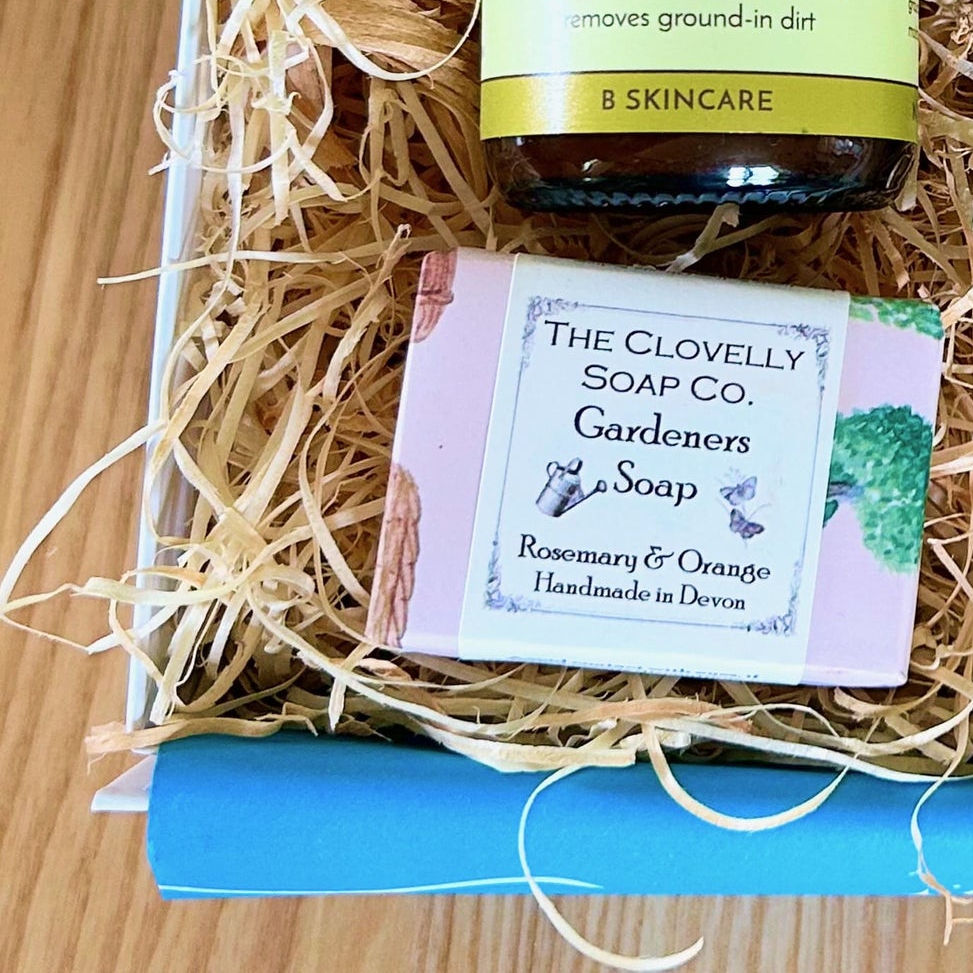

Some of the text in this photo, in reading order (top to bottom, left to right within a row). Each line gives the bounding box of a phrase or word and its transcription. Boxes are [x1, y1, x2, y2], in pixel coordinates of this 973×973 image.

[563, 3, 817, 32] removes ground-in dirt
[602, 88, 774, 112] B SKINCARE
[544, 319, 805, 371] THE CLOVELLY
[581, 363, 754, 406] SOAP CO.
[573, 404, 751, 454] Gardeners
[613, 459, 698, 507] Soap
[518, 533, 771, 584] Rosemary & Orange
[534, 570, 746, 611] Handmade in Devon
